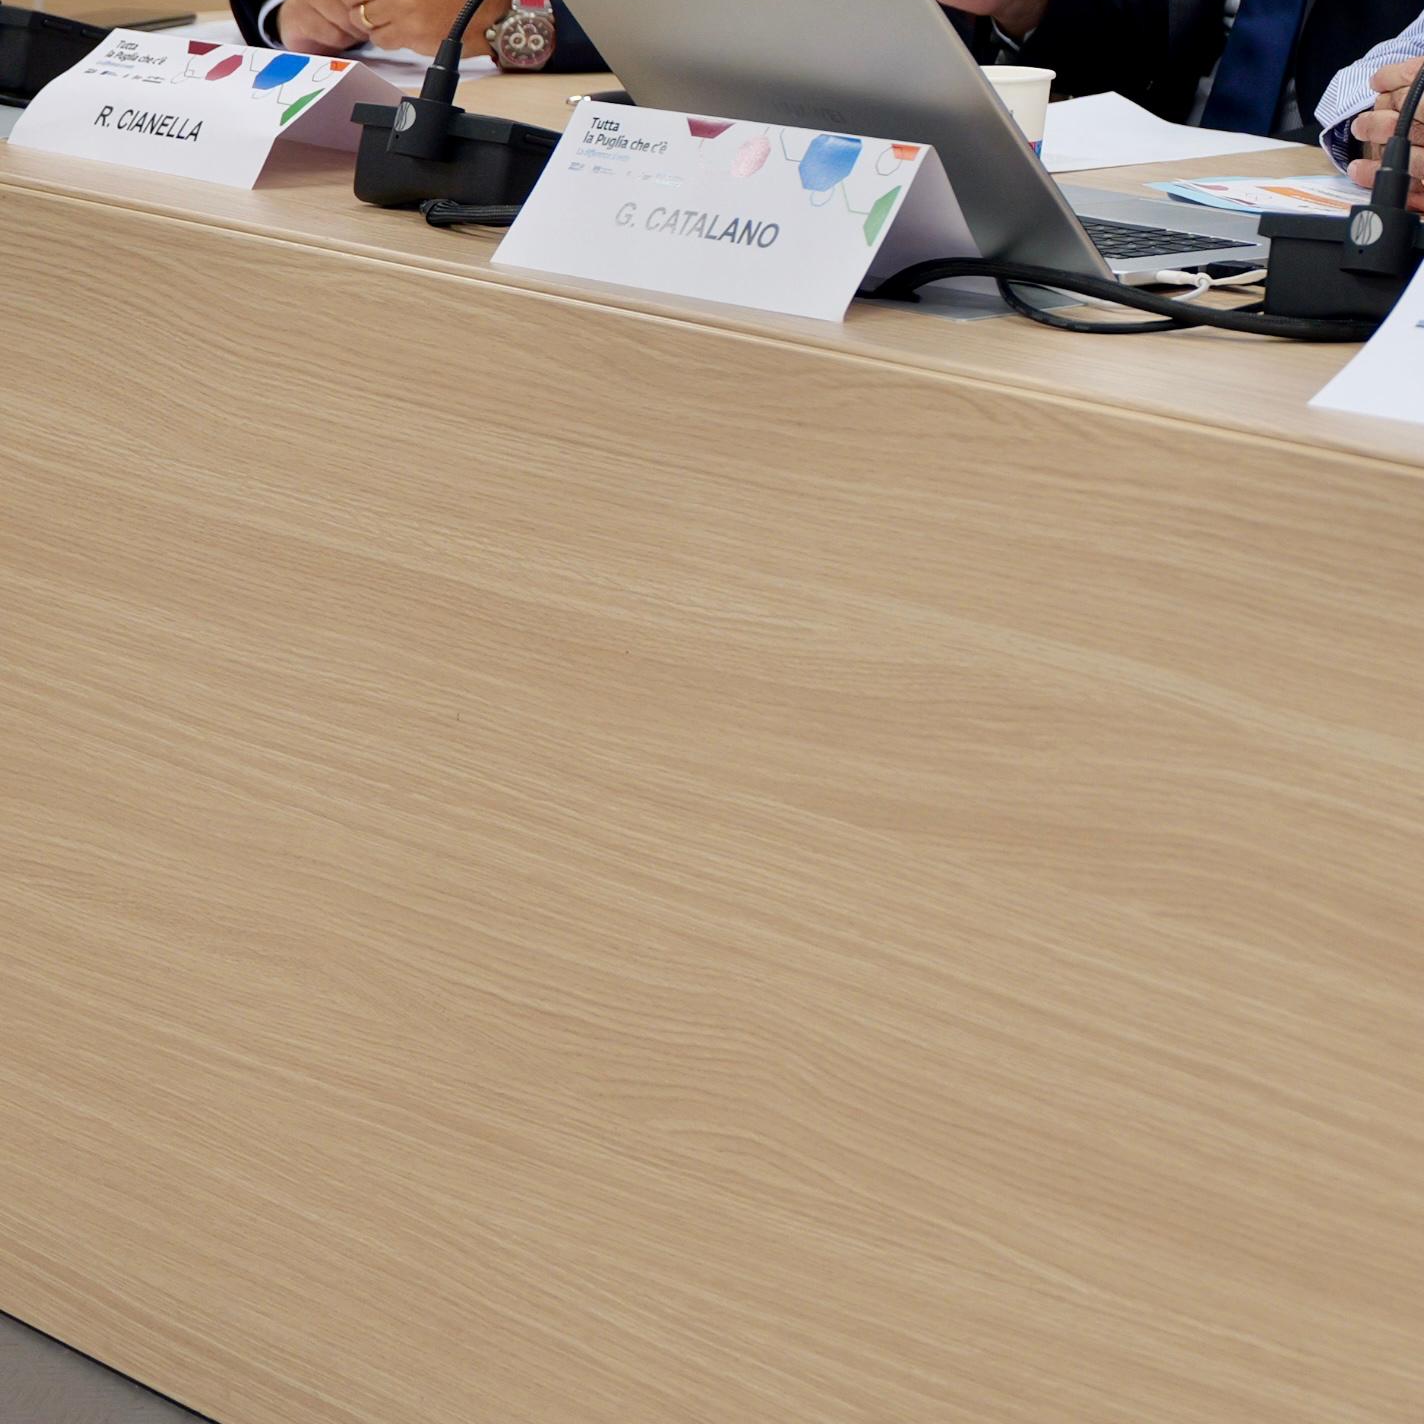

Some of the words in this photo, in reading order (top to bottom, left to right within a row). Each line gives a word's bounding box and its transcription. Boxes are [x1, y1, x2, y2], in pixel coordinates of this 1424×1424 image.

[94, 105, 114, 128] R.
[117, 109, 204, 142] CIANELLA
[591, 117, 620, 132] Tutta
[582, 131, 594, 144] la
[595, 133, 629, 150] Puglia
[630, 138, 650, 153] che
[615, 201, 637, 228] G.
[645, 206, 780, 249] CATALANO
